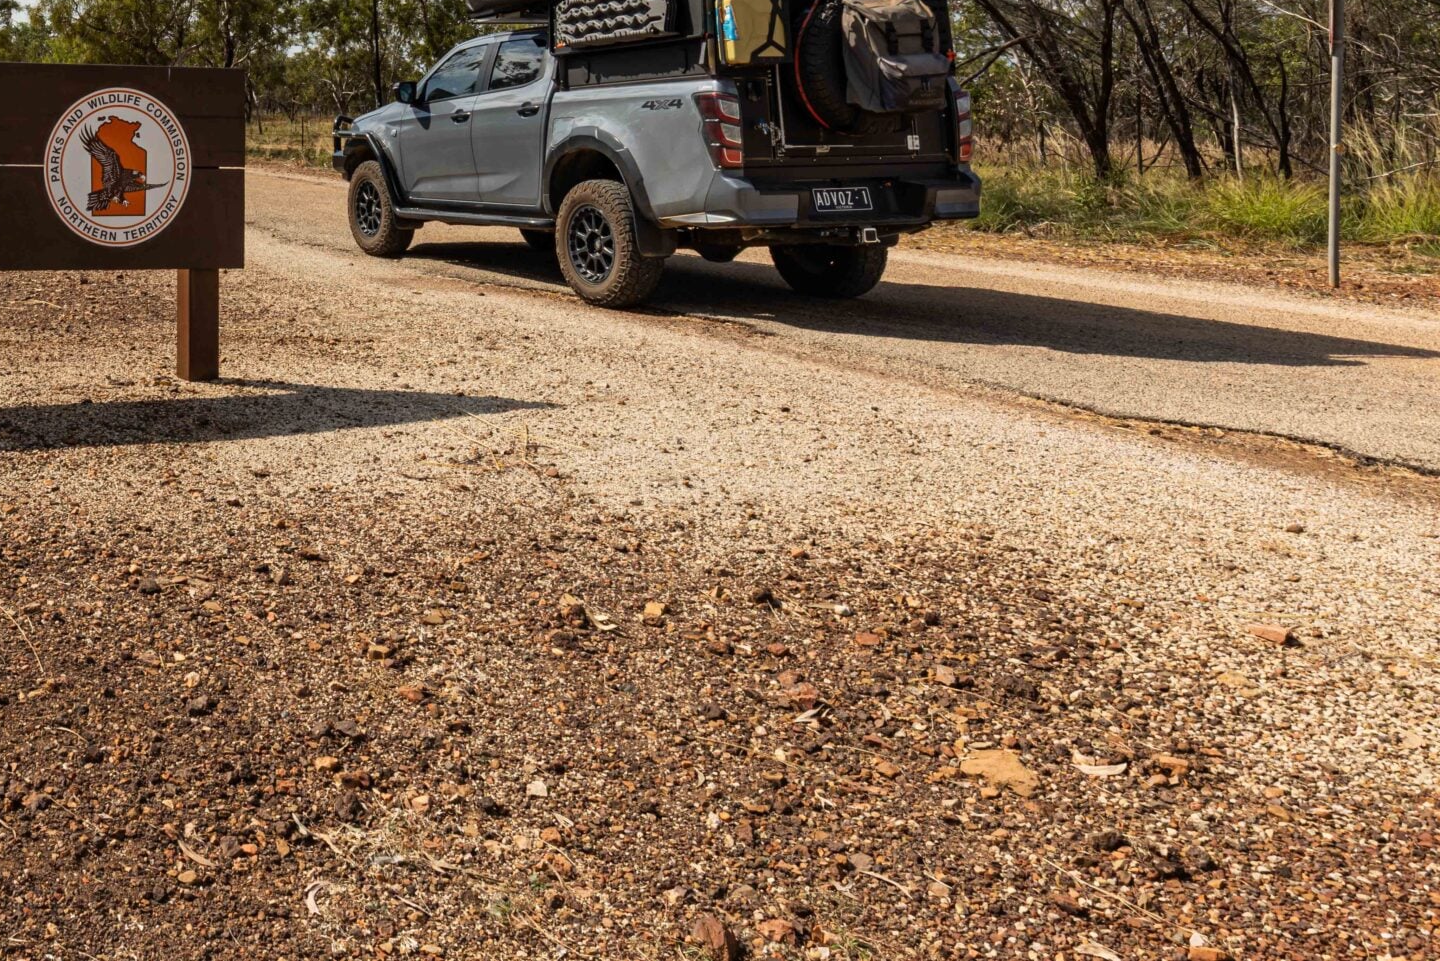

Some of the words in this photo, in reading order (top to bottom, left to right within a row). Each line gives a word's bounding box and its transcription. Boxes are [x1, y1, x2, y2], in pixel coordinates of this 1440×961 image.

[50, 136, 65, 183] PARKS
[62, 108, 84, 134] AND
[87, 93, 142, 110] WILDLIFE
[146, 102, 186, 181] COMMISSION
[57, 196, 117, 241] NORTHERN
[123, 195, 179, 241] TERRITORY
